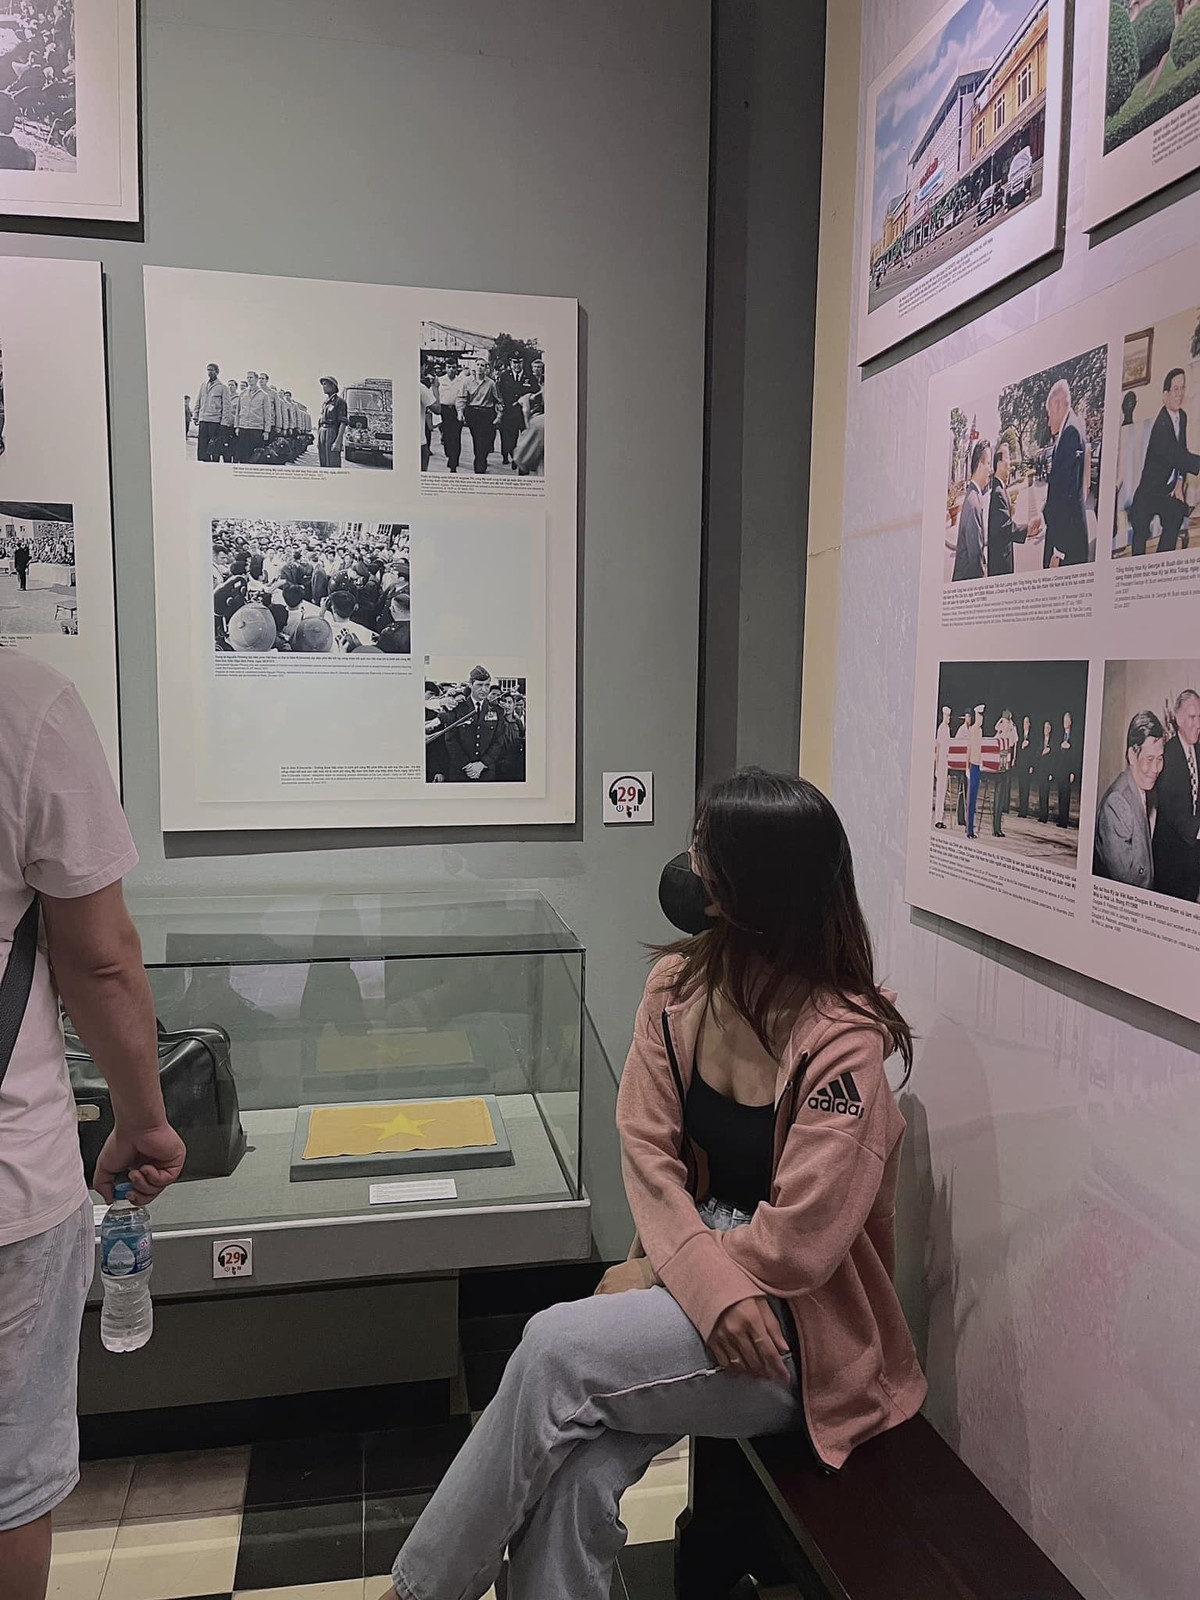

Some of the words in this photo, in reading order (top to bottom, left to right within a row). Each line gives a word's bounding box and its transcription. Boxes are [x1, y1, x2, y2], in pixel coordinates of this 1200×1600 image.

[618, 786, 636, 802] 29
[808, 1096, 864, 1119] adidas
[226, 1252, 240, 1265] 29
